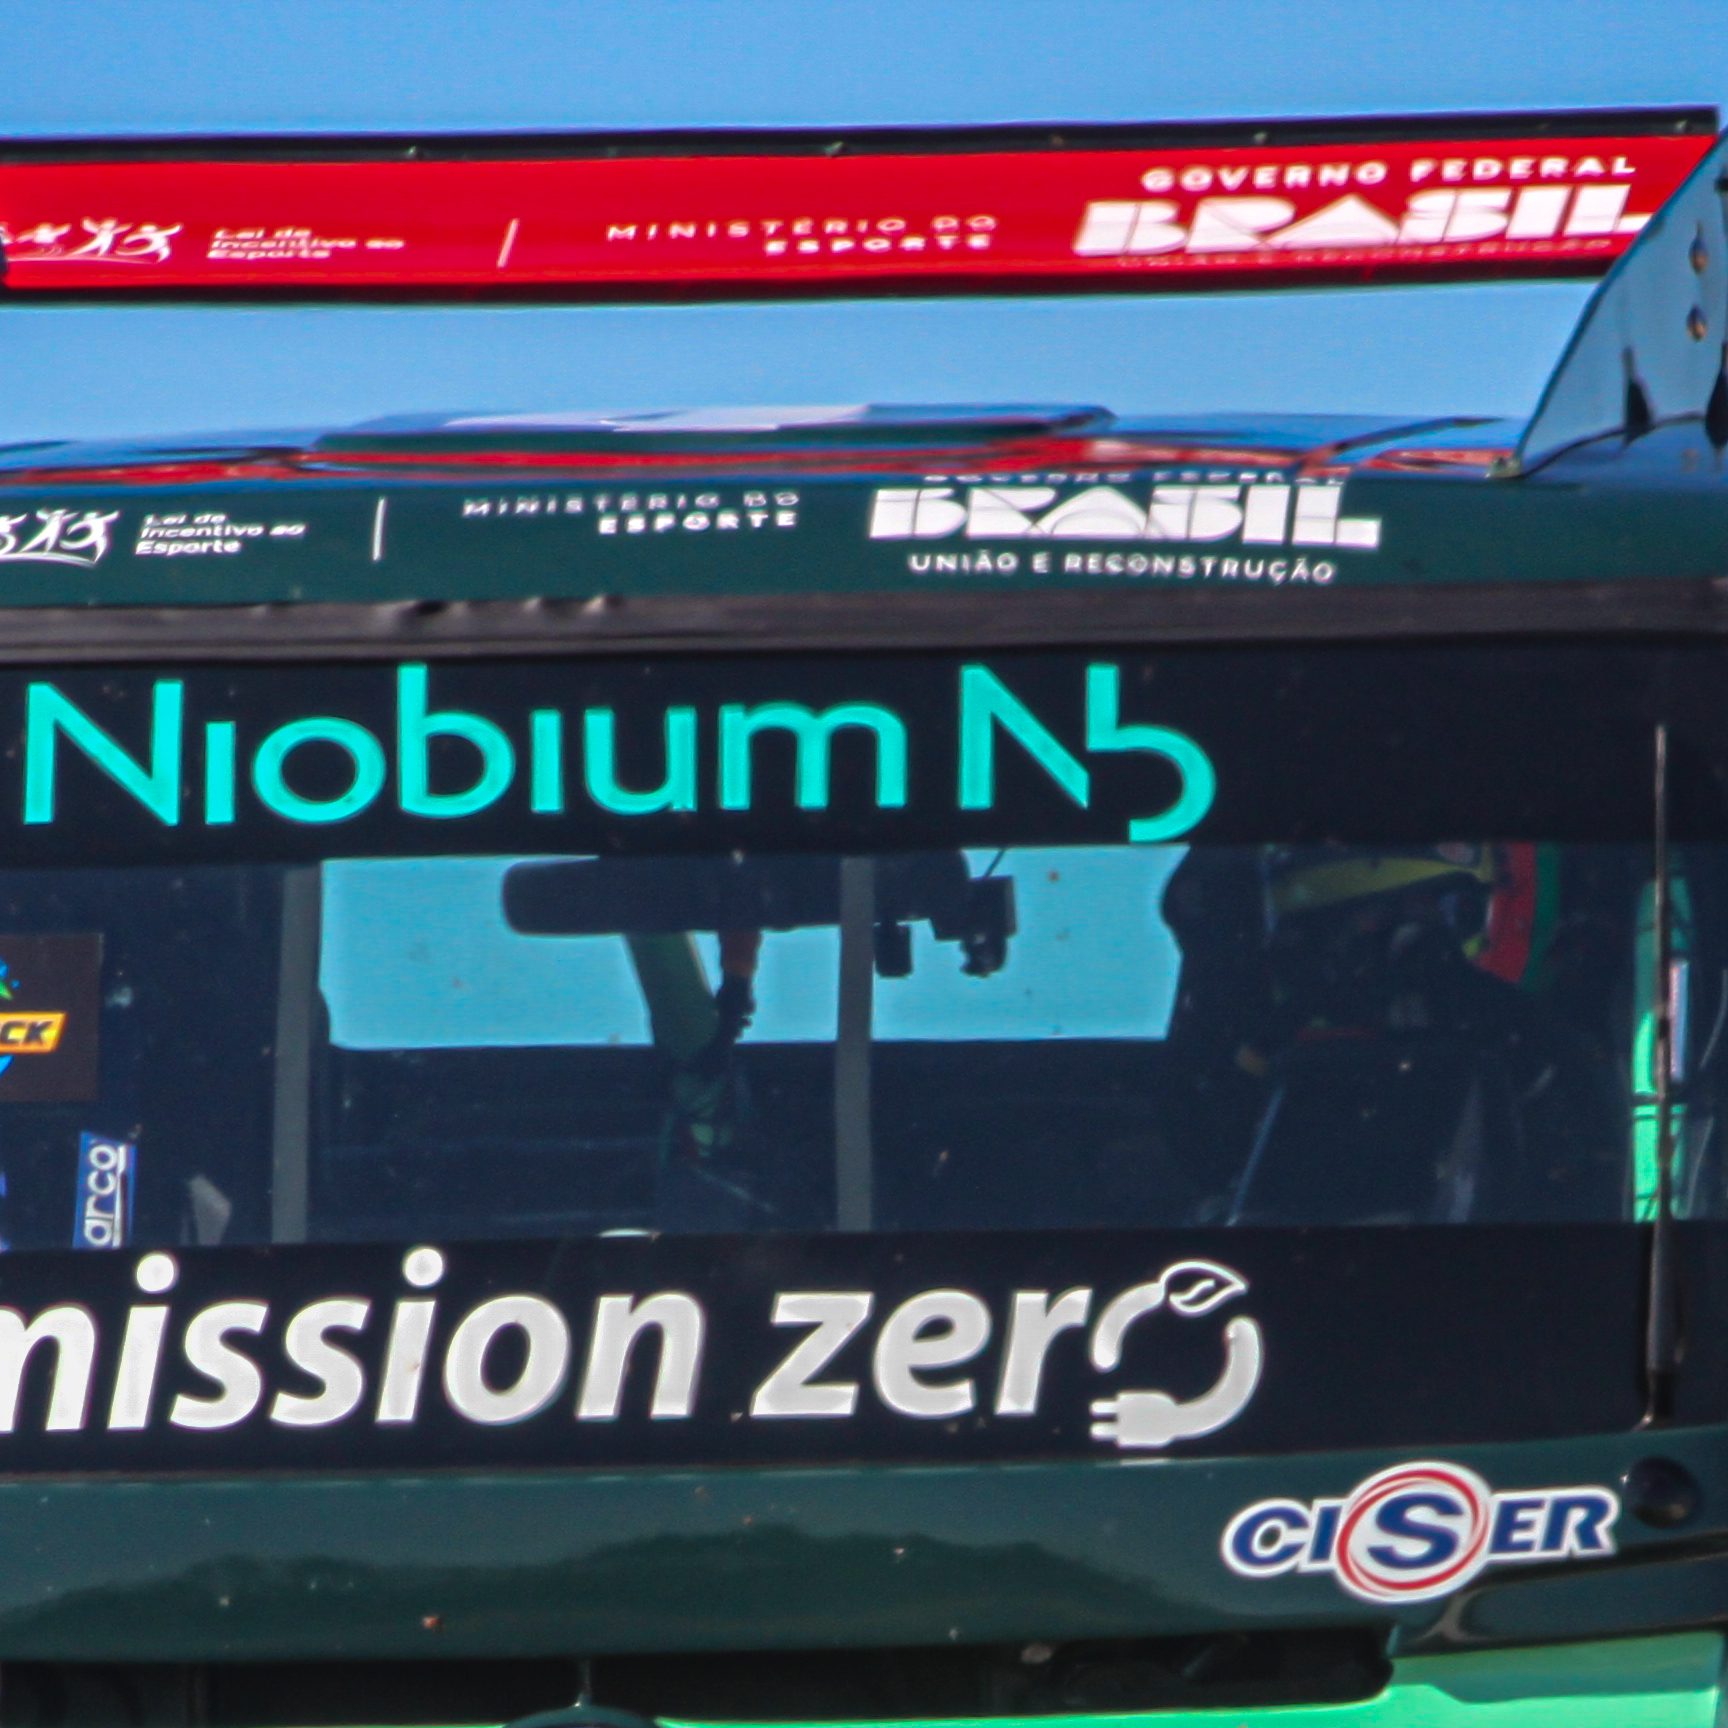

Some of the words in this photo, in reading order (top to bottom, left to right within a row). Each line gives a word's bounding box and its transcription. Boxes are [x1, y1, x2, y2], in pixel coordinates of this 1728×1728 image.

[1141, 160, 1388, 193] GOVERNO
[1410, 155, 1637, 183] FEDERAL
[1073, 184, 1651, 256] BRASIL
[765, 233, 993, 256] ESPORTE
[140, 524, 266, 539] Incentivo
[597, 510, 798, 535] ESPORTE
[870, 486, 1381, 549] BRASIL
[135, 539, 242, 557] Esporte
[908, 550, 1019, 574] UNIÃO
[1032, 553, 1050, 573] E
[1064, 552, 1336, 586] RECONSTRUÇÃO
[23, 663, 908, 824] Niobium
[1223, 1487, 1616, 1576] CISER
